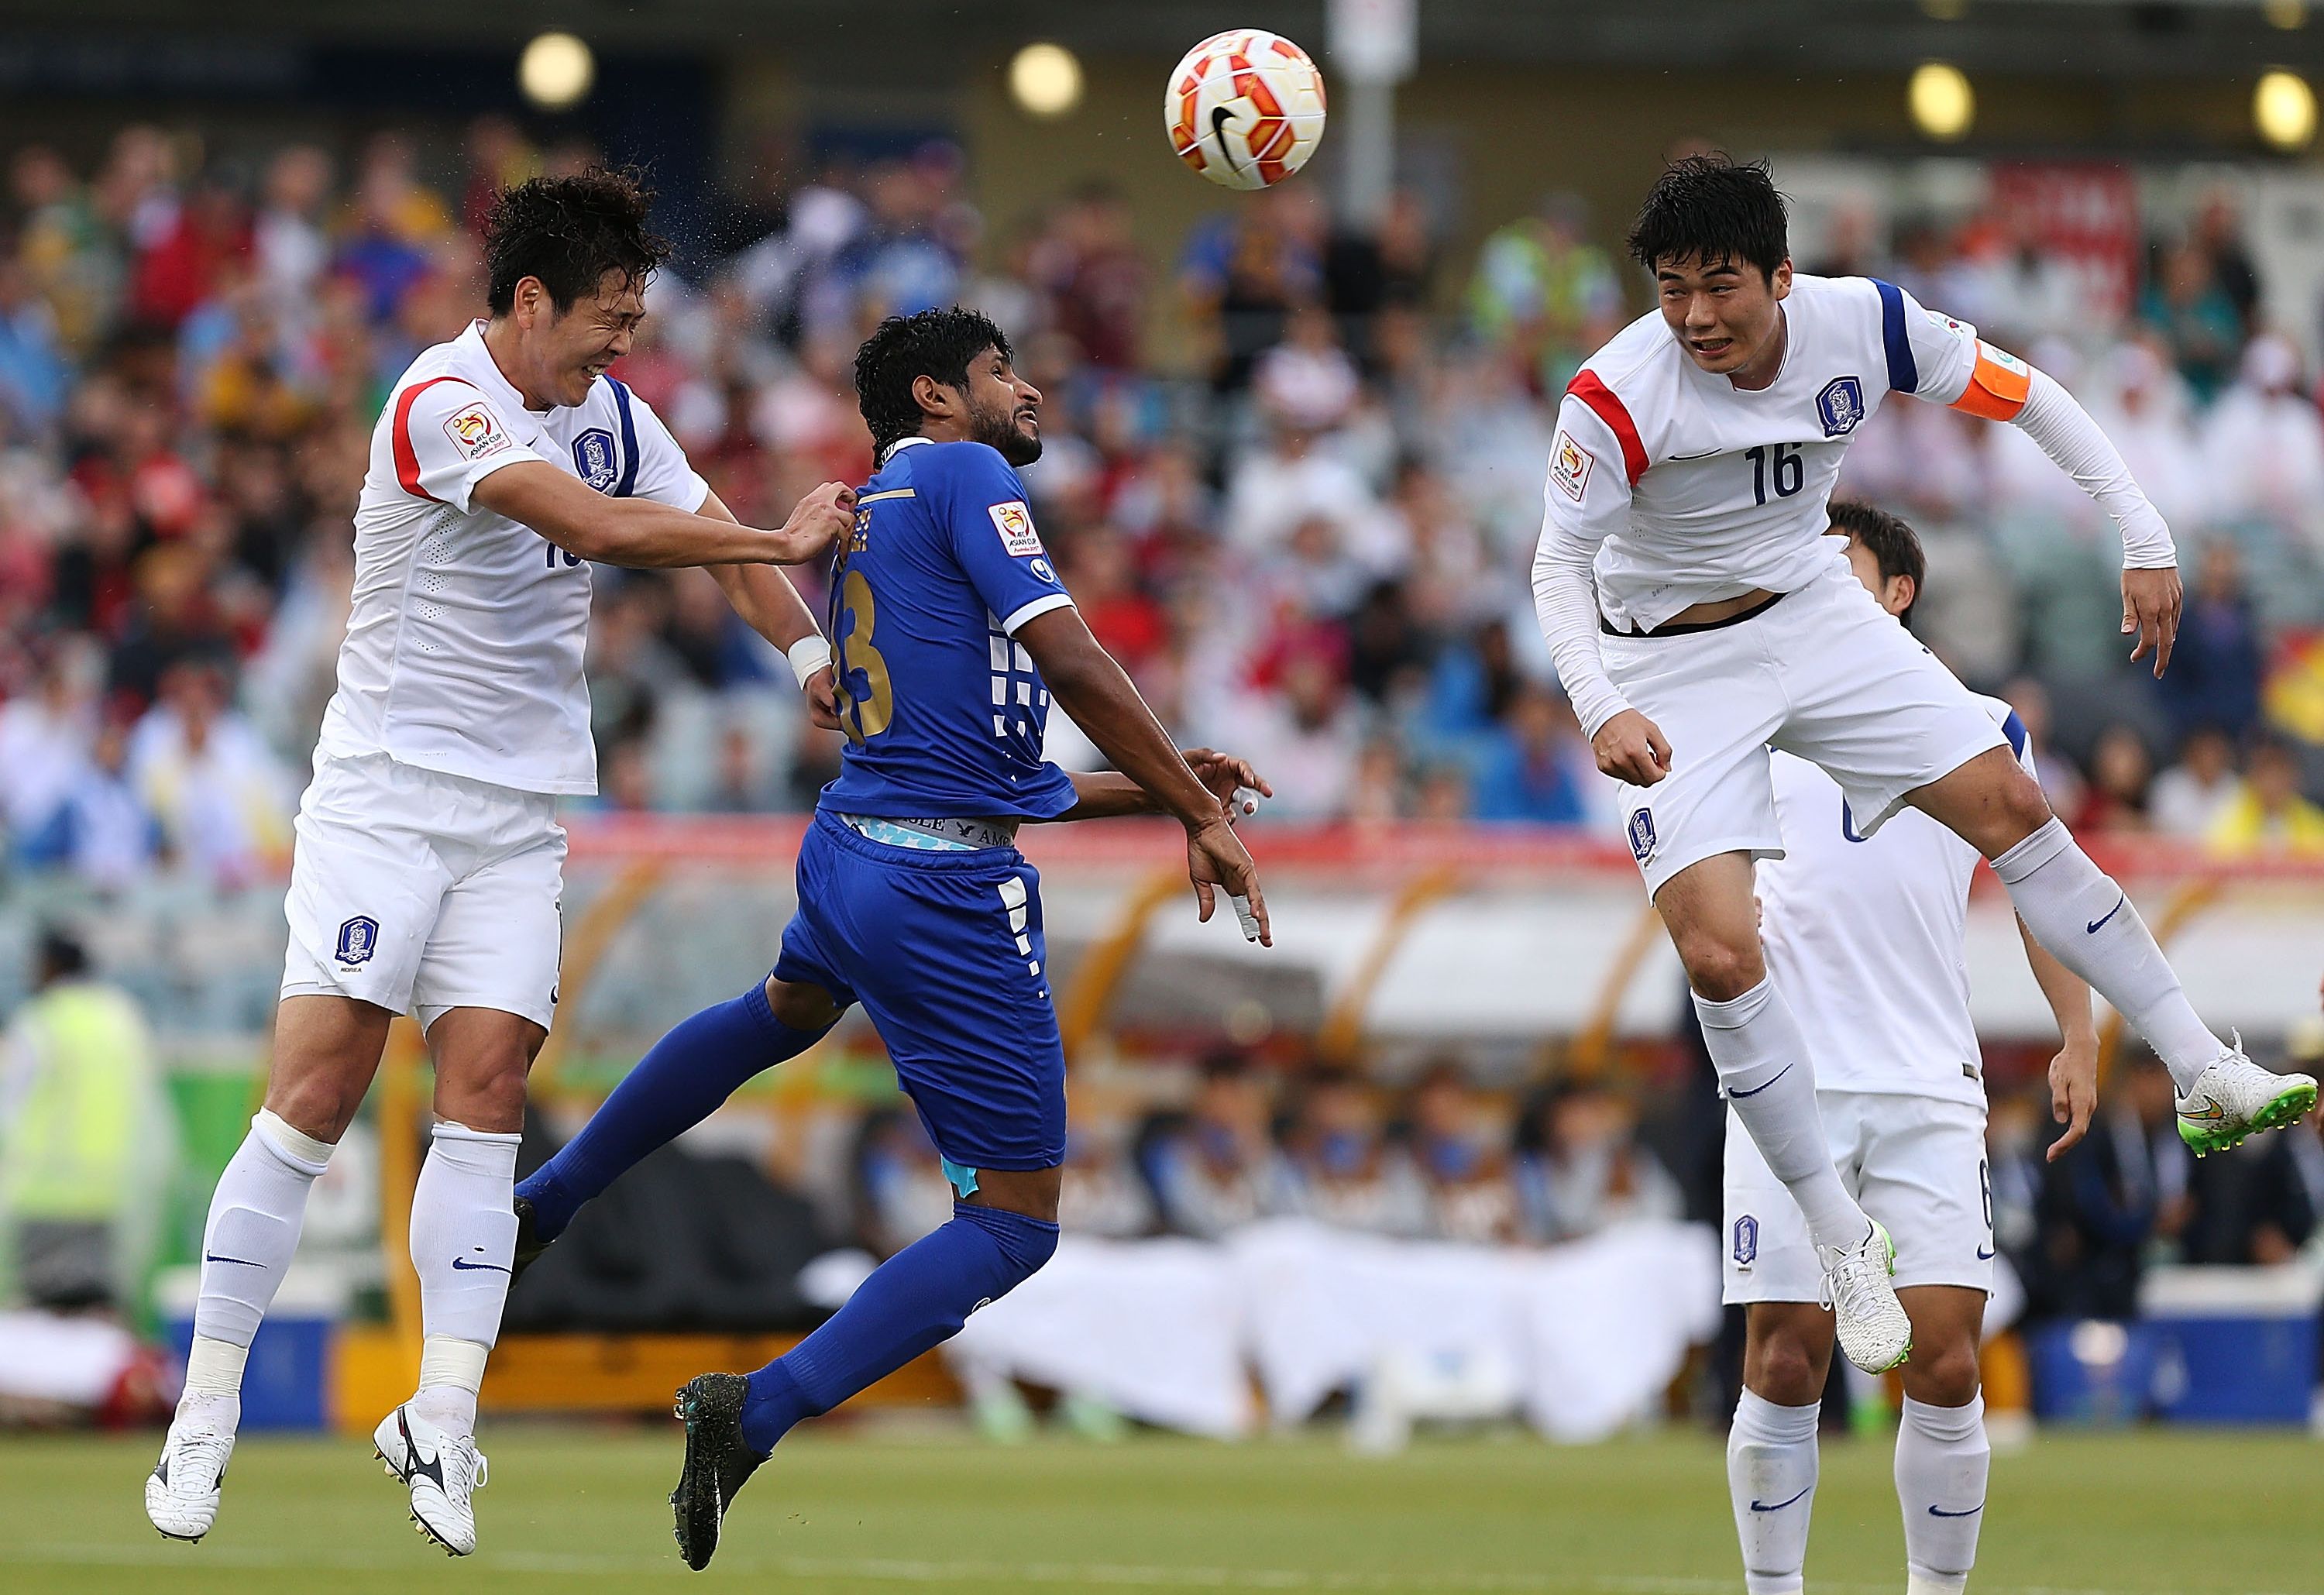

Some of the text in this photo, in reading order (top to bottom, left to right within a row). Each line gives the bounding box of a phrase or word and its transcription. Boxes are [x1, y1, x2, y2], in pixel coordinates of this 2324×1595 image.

[470, 433, 501, 459] ASIAN CUP
[1554, 466, 1580, 490] ASIAN CUP
[1744, 442, 1804, 507] 16
[1009, 538, 1026, 547] ASIAN
